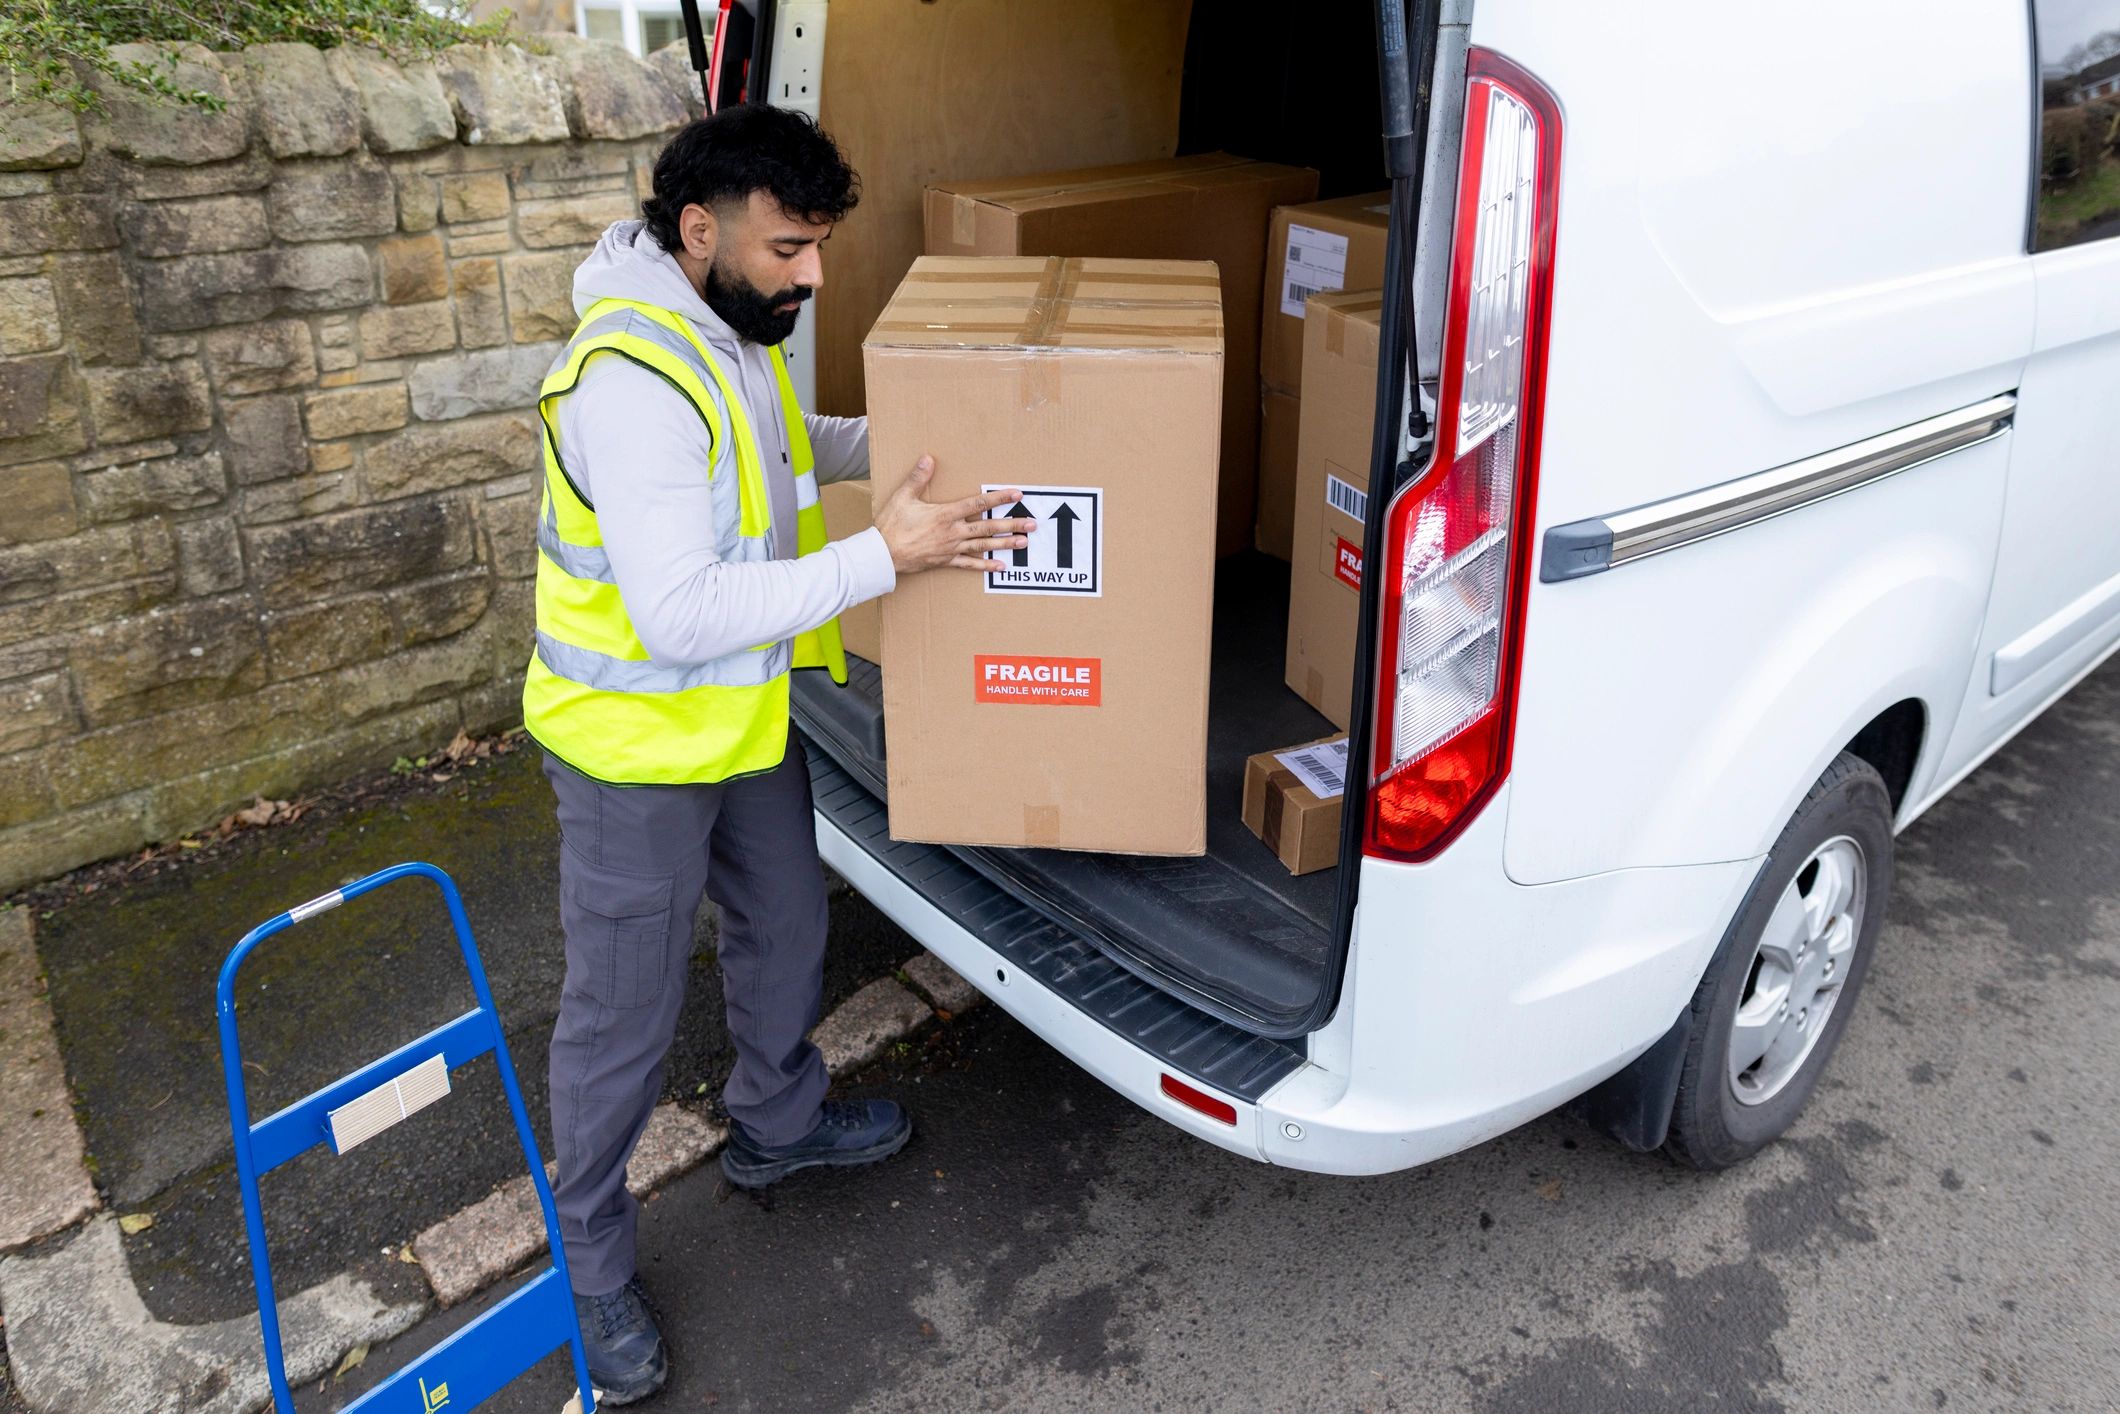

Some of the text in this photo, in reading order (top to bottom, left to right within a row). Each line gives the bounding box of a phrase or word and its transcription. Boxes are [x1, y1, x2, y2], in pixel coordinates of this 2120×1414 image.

[1000, 571, 1088, 584] THIS WAY UP
[985, 664, 1091, 684] FRAGILE
[986, 685, 1090, 697] HANDLE WITH CARE
